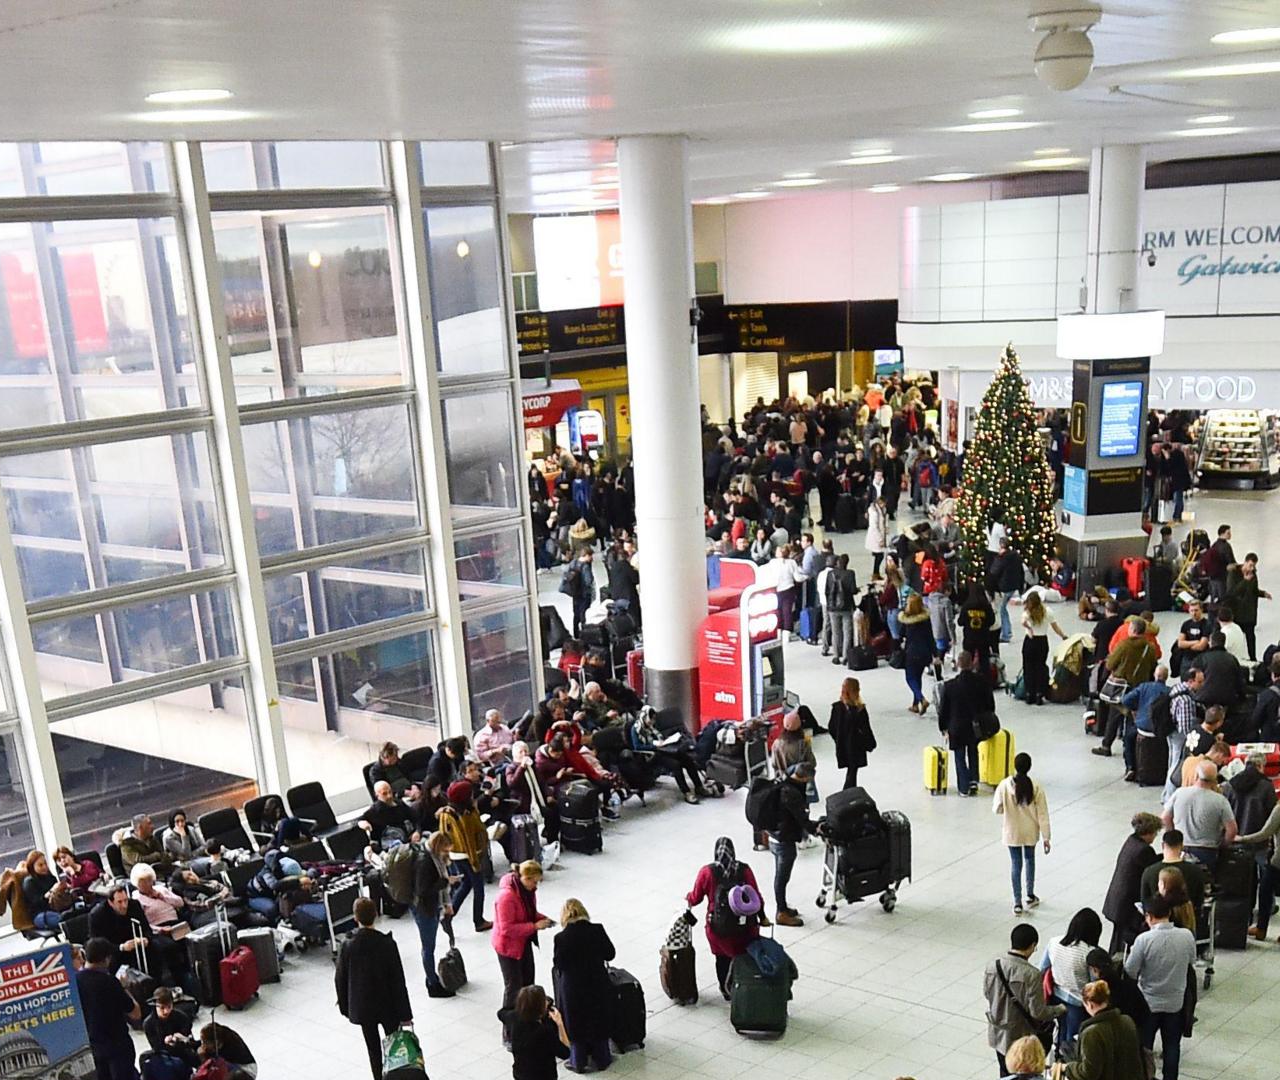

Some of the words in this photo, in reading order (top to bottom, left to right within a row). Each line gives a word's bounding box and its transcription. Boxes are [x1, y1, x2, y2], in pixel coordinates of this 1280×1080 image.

[1181, 376, 1257, 402] FOOD
[714, 690, 736, 705] atm
[5, 963, 30, 979] THE
[32, 972, 66, 988] TOUR
[23, 988, 72, 1009] HOP-OFF
[40, 1005, 76, 1025] HERE
